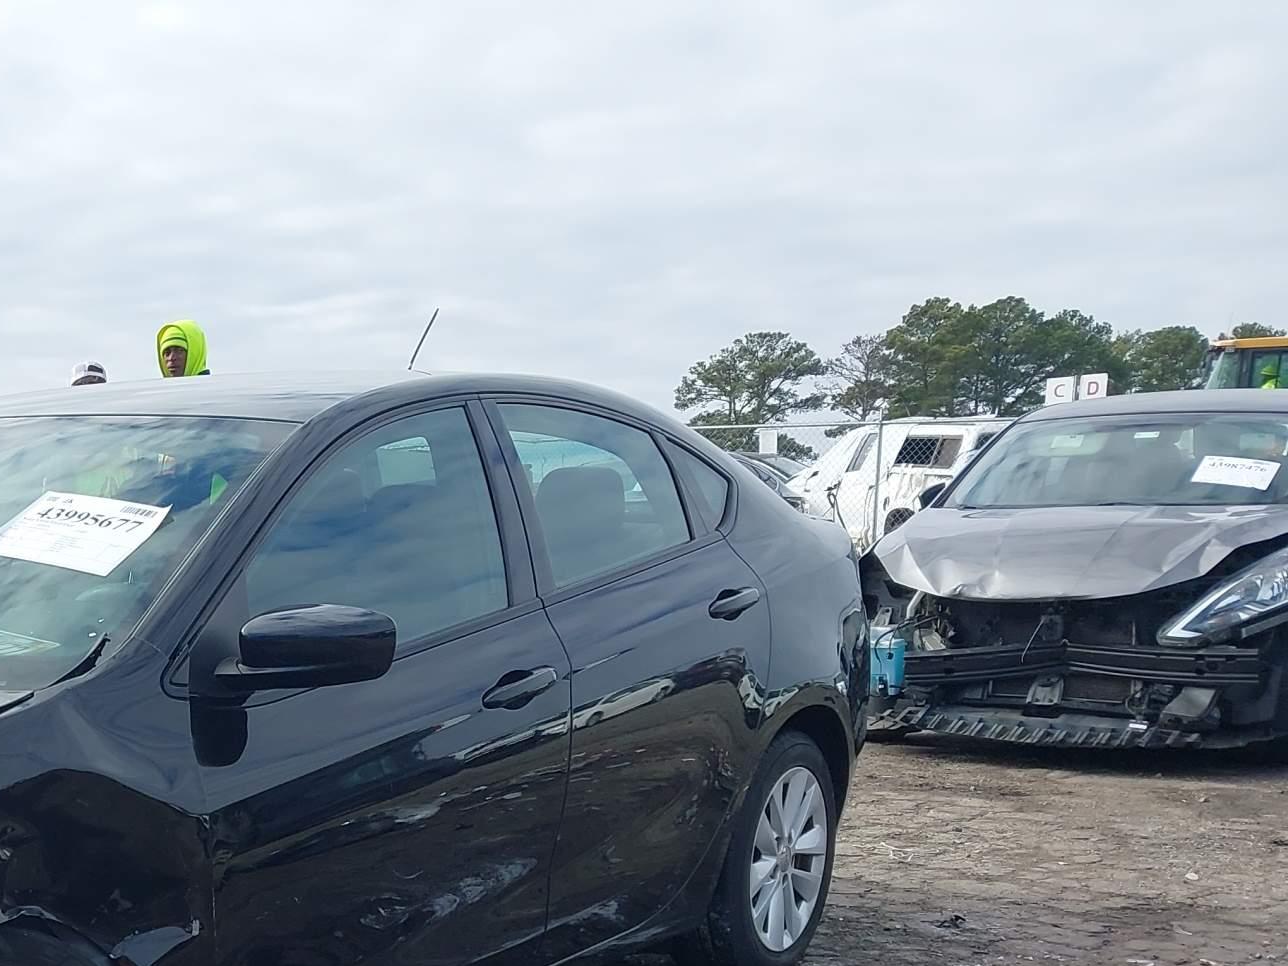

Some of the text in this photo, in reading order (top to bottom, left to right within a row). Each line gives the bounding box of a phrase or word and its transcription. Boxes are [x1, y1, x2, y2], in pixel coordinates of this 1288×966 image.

[1054, 383, 1066, 398] C
[1087, 381, 1100, 396] D
[37, 506, 144, 534] 43995677
